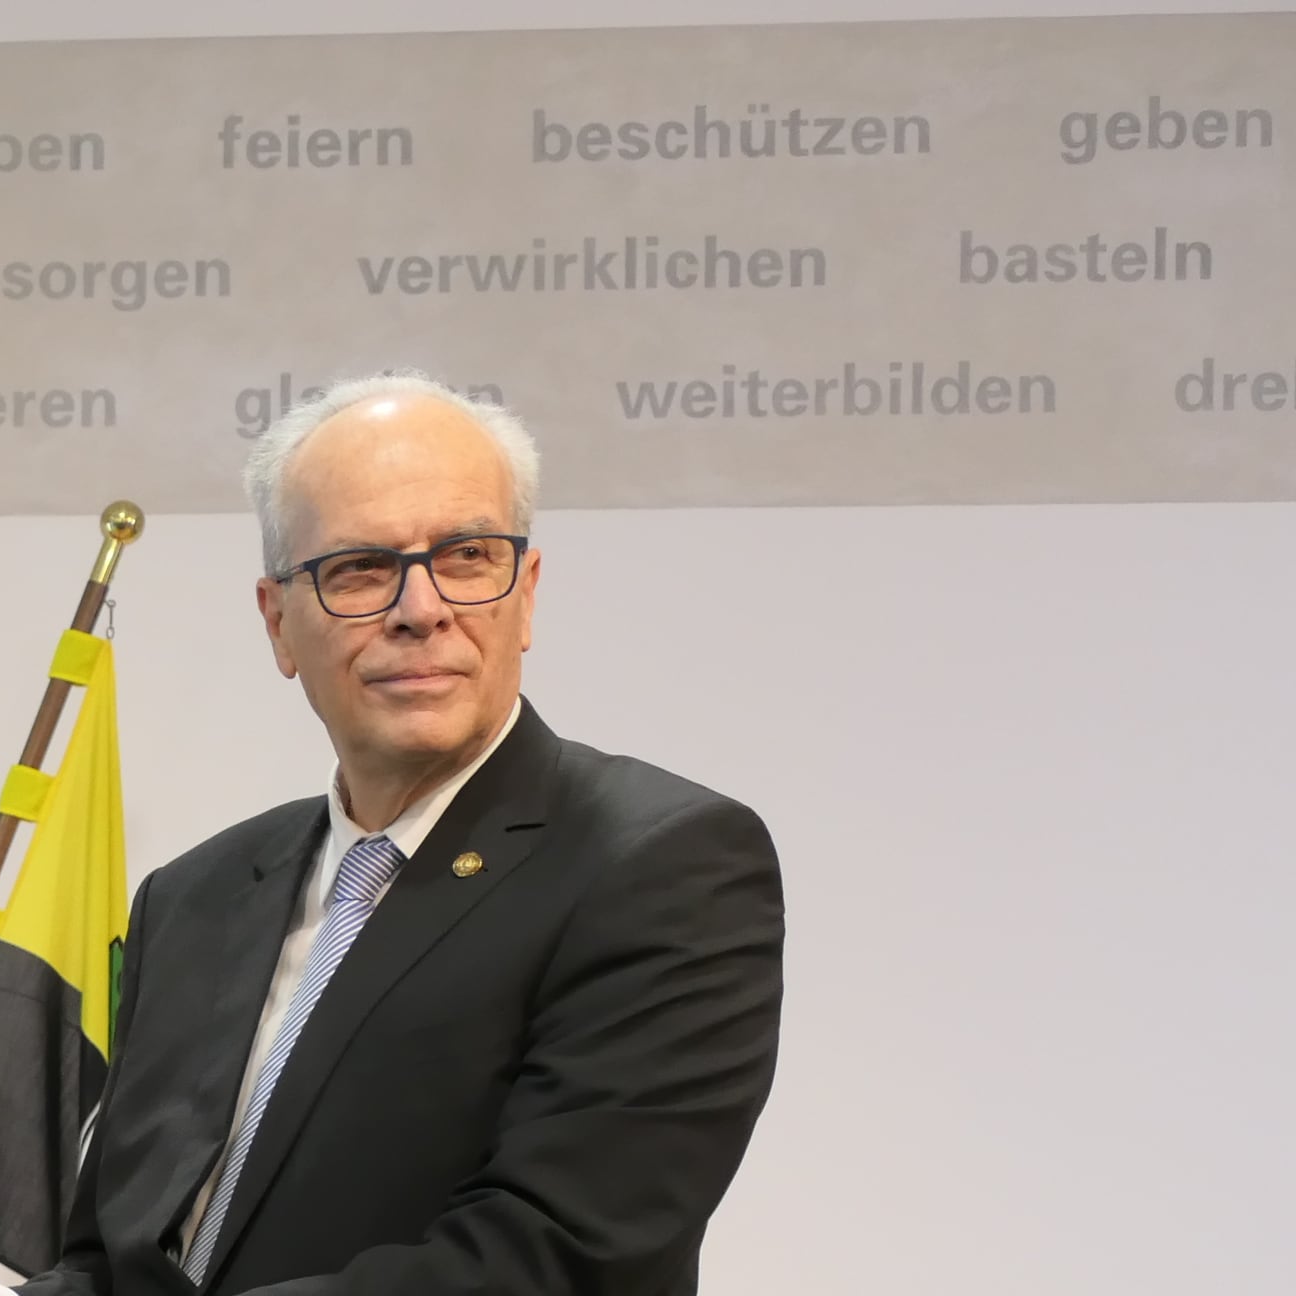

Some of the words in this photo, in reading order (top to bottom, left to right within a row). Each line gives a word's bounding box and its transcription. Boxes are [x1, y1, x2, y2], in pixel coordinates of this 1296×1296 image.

[217, 113, 414, 170] feiern
[532, 103, 931, 164] beschützen
[1059, 95, 1273, 165] geben
[2, 258, 231, 312] sorgen
[356, 234, 827, 296] verwirklichen
[959, 226, 1213, 285] basteln
[615, 360, 1056, 419] weiterbilden
